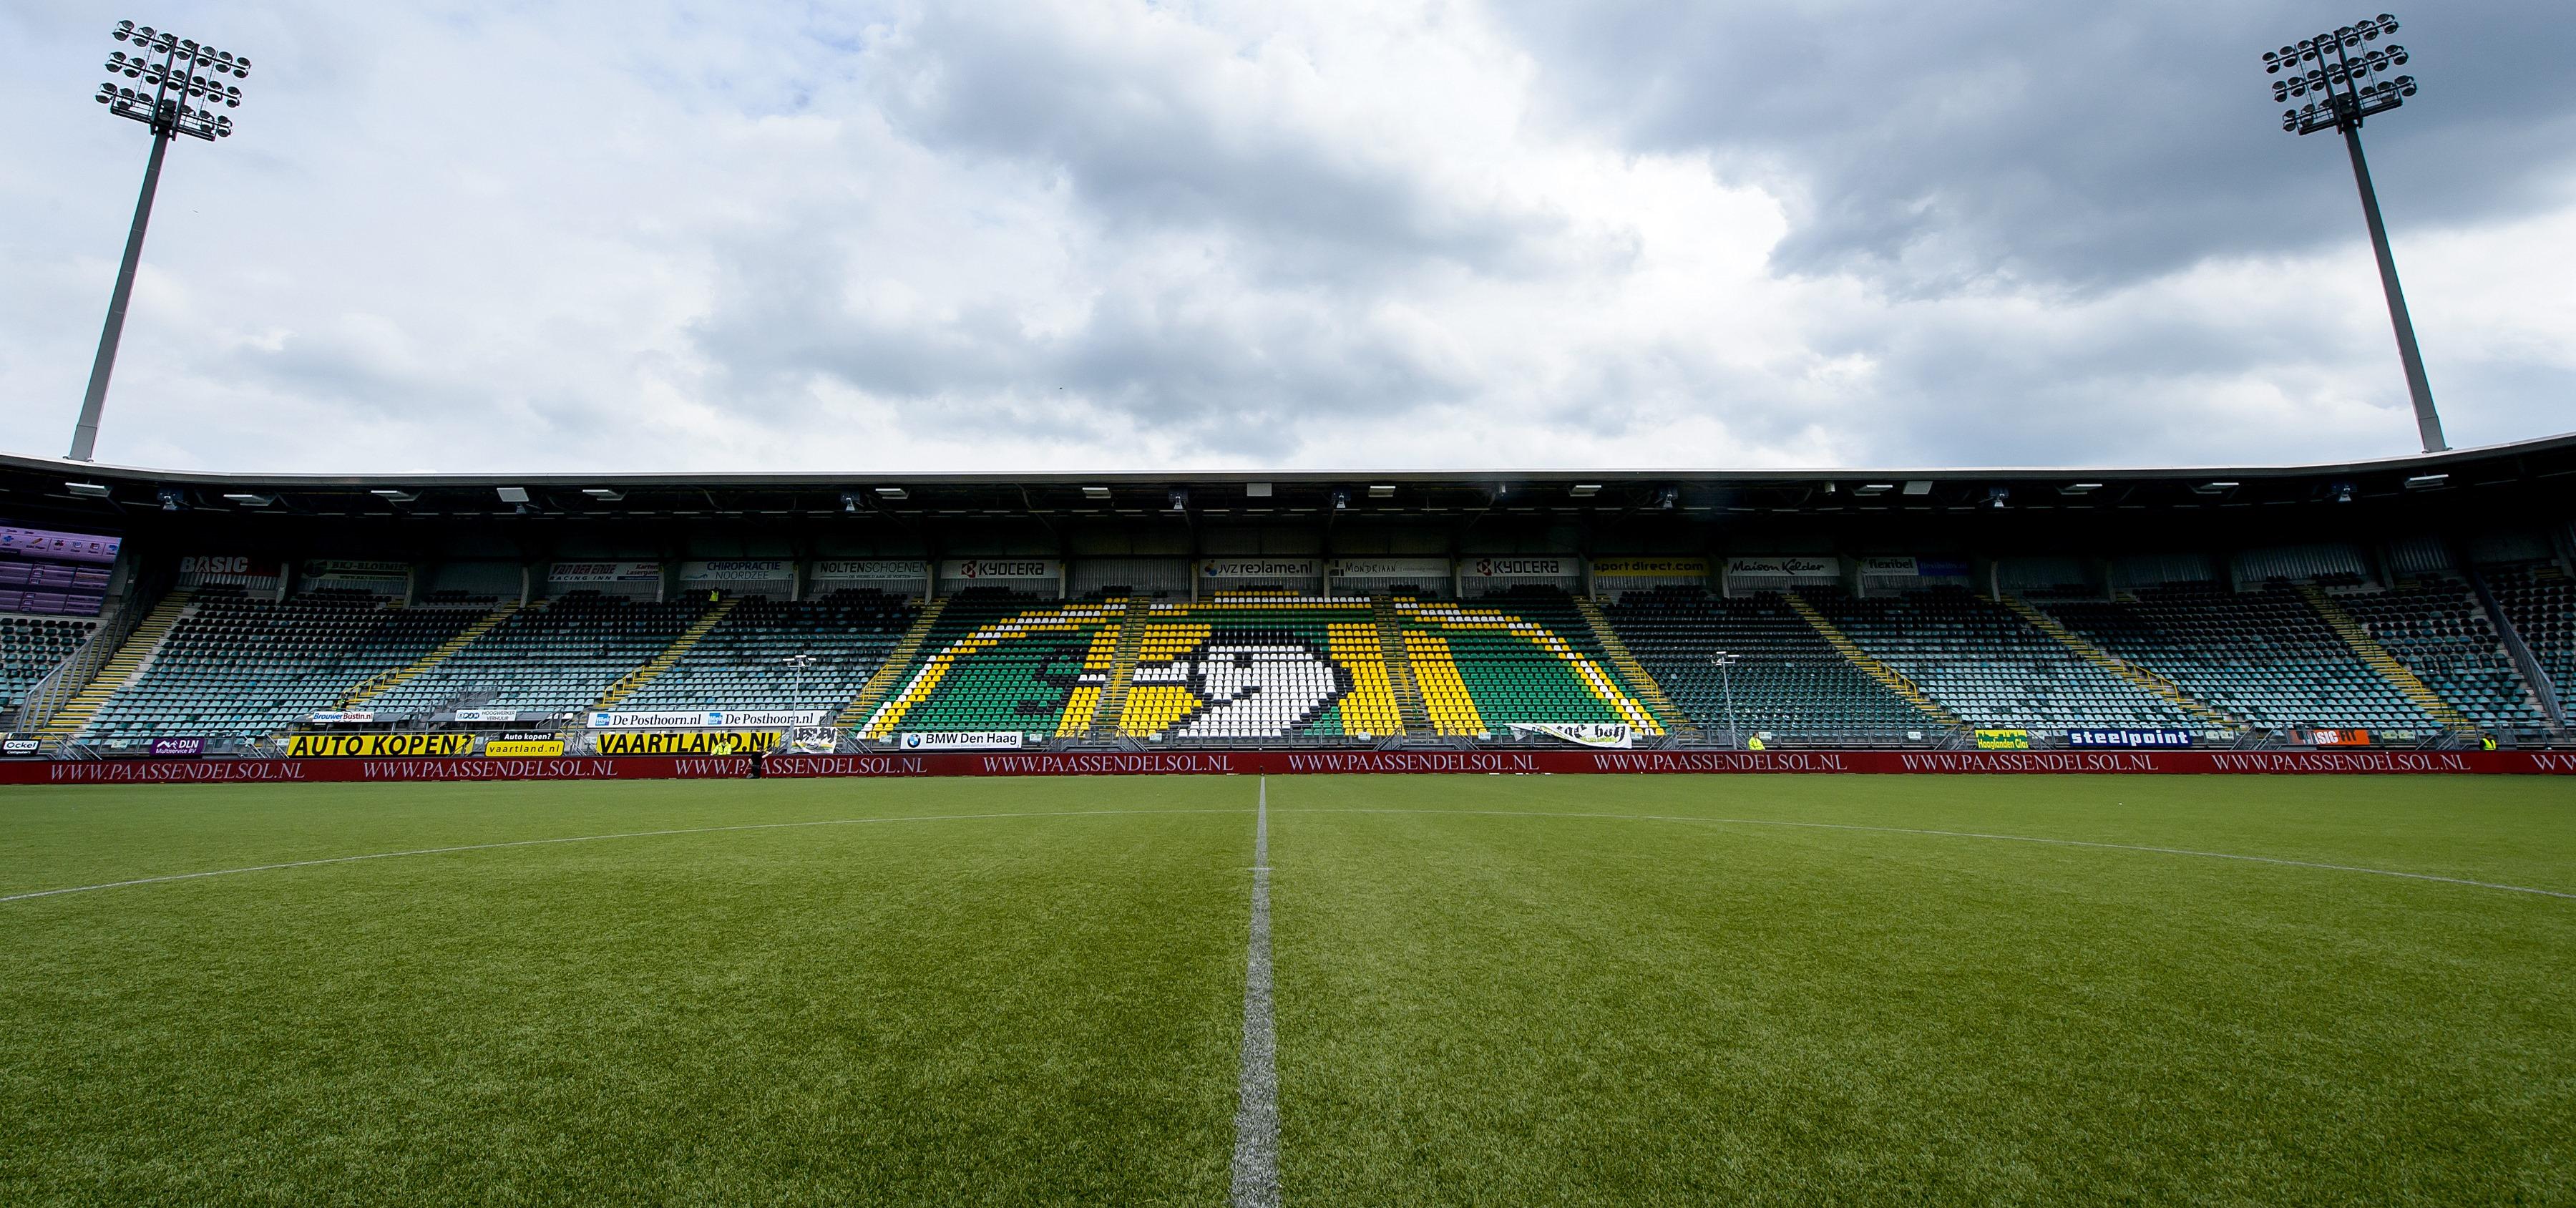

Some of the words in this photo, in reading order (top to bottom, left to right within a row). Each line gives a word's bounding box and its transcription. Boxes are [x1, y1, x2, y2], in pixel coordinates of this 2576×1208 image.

[180, 556, 249, 573] BASIC
[707, 562, 781, 570] CHIROPRACTIE
[820, 562, 927, 573] NOLTENSCHOENEN
[978, 562, 1045, 575] KYOCERA
[1493, 560, 1559, 574] KYOCERA
[1730, 561, 1779, 574] Maison
[1781, 559, 1825, 575] Kelder
[1869, 559, 1913, 569] flexibel
[613, 715, 628, 726] De
[630, 714, 701, 725] Posthoorn.nl
[725, 713, 741, 724] De
[743, 713, 814, 724] Posthoorn.nl
[291, 736, 364, 756] AUTO
[371, 734, 472, 756] KOPEN?
[925, 733, 958, 744] BMW
[960, 733, 983, 744] Den
[987, 733, 1017, 745] Haag
[1977, 739, 2015, 750] Haaglanden
[2015, 739, 2029, 749] Glas
[2072, 729, 2189, 746] steelpoint
[364, 761, 618, 776] WWW.PAASSENDELSOL.NL
[984, 755, 1234, 771] WWW.PAASSENDELSOL.NL
[1289, 754, 1539, 770] WWW.PAASSENDELSOL.NL
[1594, 754, 1848, 770] WWW.PAASSENDELSOL.NL
[1901, 754, 2159, 770] WWW.PAASSENDELSOL.NL
[2211, 754, 2471, 770] WWW.PAASSENDELSOL.NL
[52, 763, 305, 779] WWW.PAASSENDELSOL.NL
